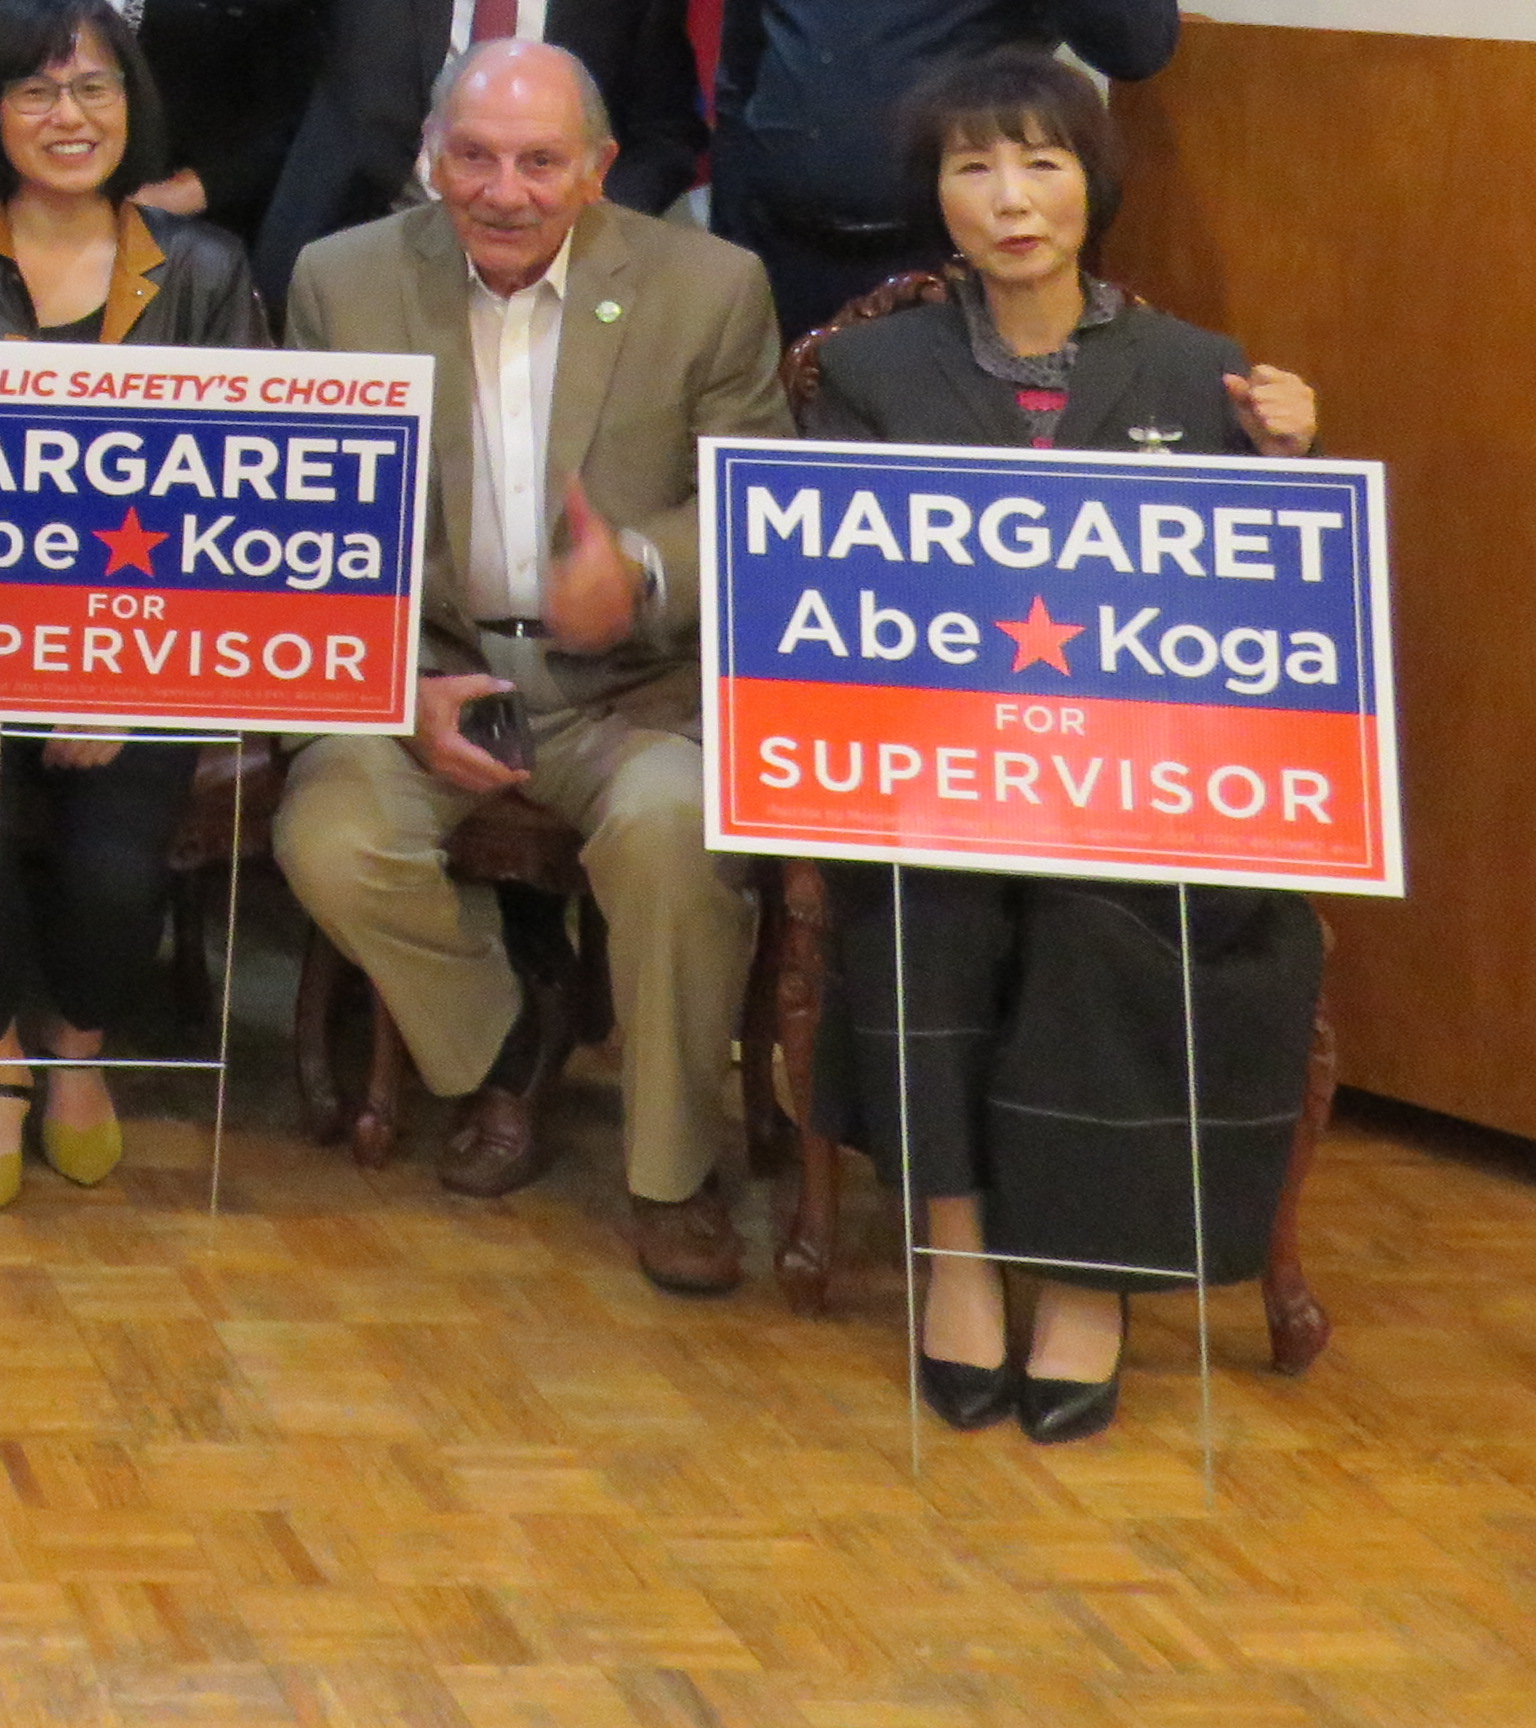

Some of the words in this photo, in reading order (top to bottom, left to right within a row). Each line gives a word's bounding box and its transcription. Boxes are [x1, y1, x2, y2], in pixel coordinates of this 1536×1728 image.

[68, 372, 248, 402] SAFETY'S
[260, 378, 410, 407] CHOICE
[182, 515, 380, 589] Koga
[748, 487, 1342, 581] MARGARET
[89, 594, 164, 619] FOR
[778, 590, 980, 664] Abe
[1099, 605, 1337, 694] Koga
[995, 703, 1088, 736] FOR
[760, 737, 1332, 825] SUPERVISOR
